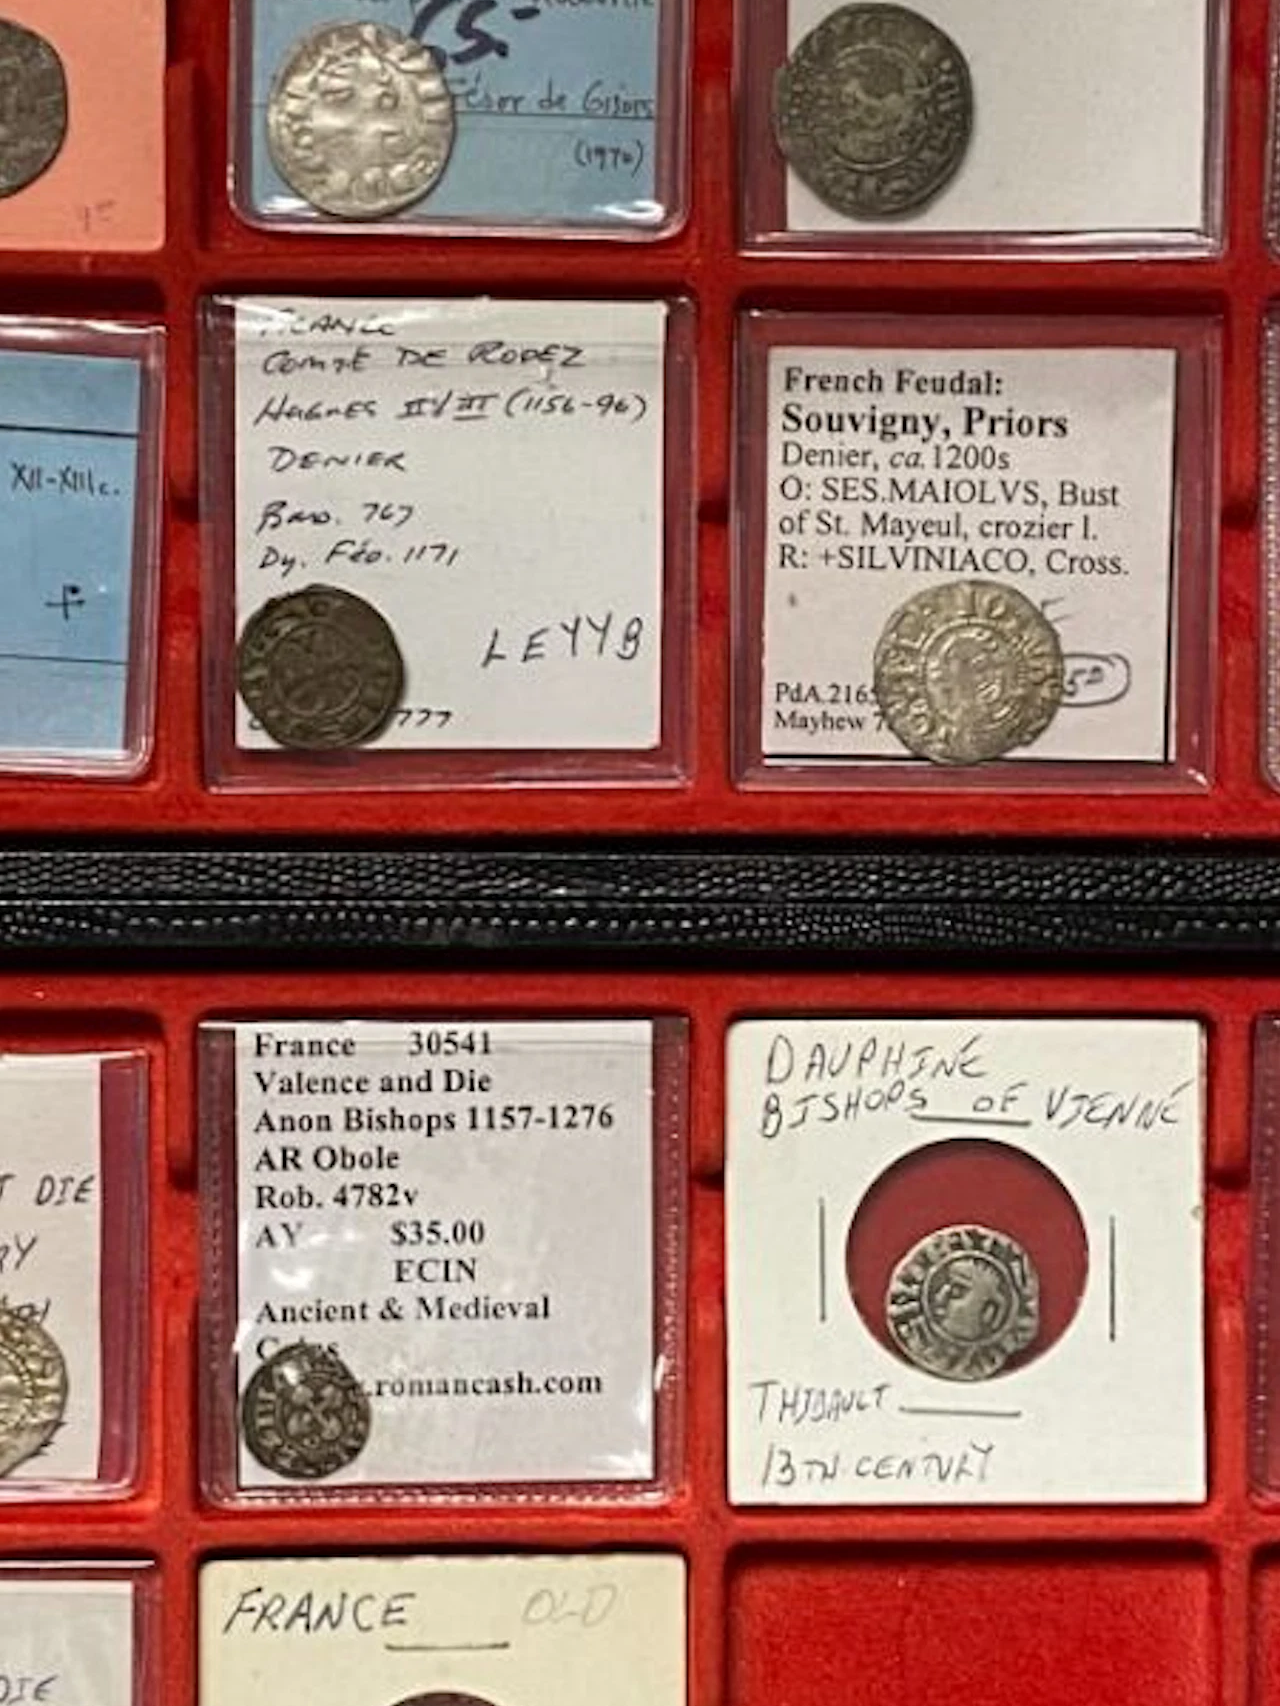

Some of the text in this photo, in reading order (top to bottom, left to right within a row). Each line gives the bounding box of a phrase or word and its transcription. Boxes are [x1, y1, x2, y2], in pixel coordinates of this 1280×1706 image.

[397, 346, 448, 368] DE
[784, 367, 1003, 396] French Feudal:
[781, 402, 1069, 442] Souvigny, Priors
[267, 446, 407, 472] DENIER
[781, 442, 879, 471] Denier,
[932, 444, 1010, 470] 1200s
[780, 510, 811, 535] of
[817, 510, 850, 536] St.
[861, 515, 969, 542] Mayeul,
[979, 518, 1074, 540] crozier
[254, 1069, 492, 1094] Valence and Die
[254, 1103, 614, 1137] Anon Bishops 1157-1276
[762, 1083, 928, 1140] BISHOPS
[973, 1083, 1026, 1114] OF
[36, 1174, 95, 1207] DIE
[256, 1296, 550, 1324] Ancient & Medieval
[222, 1587, 418, 1635] FRANCE
